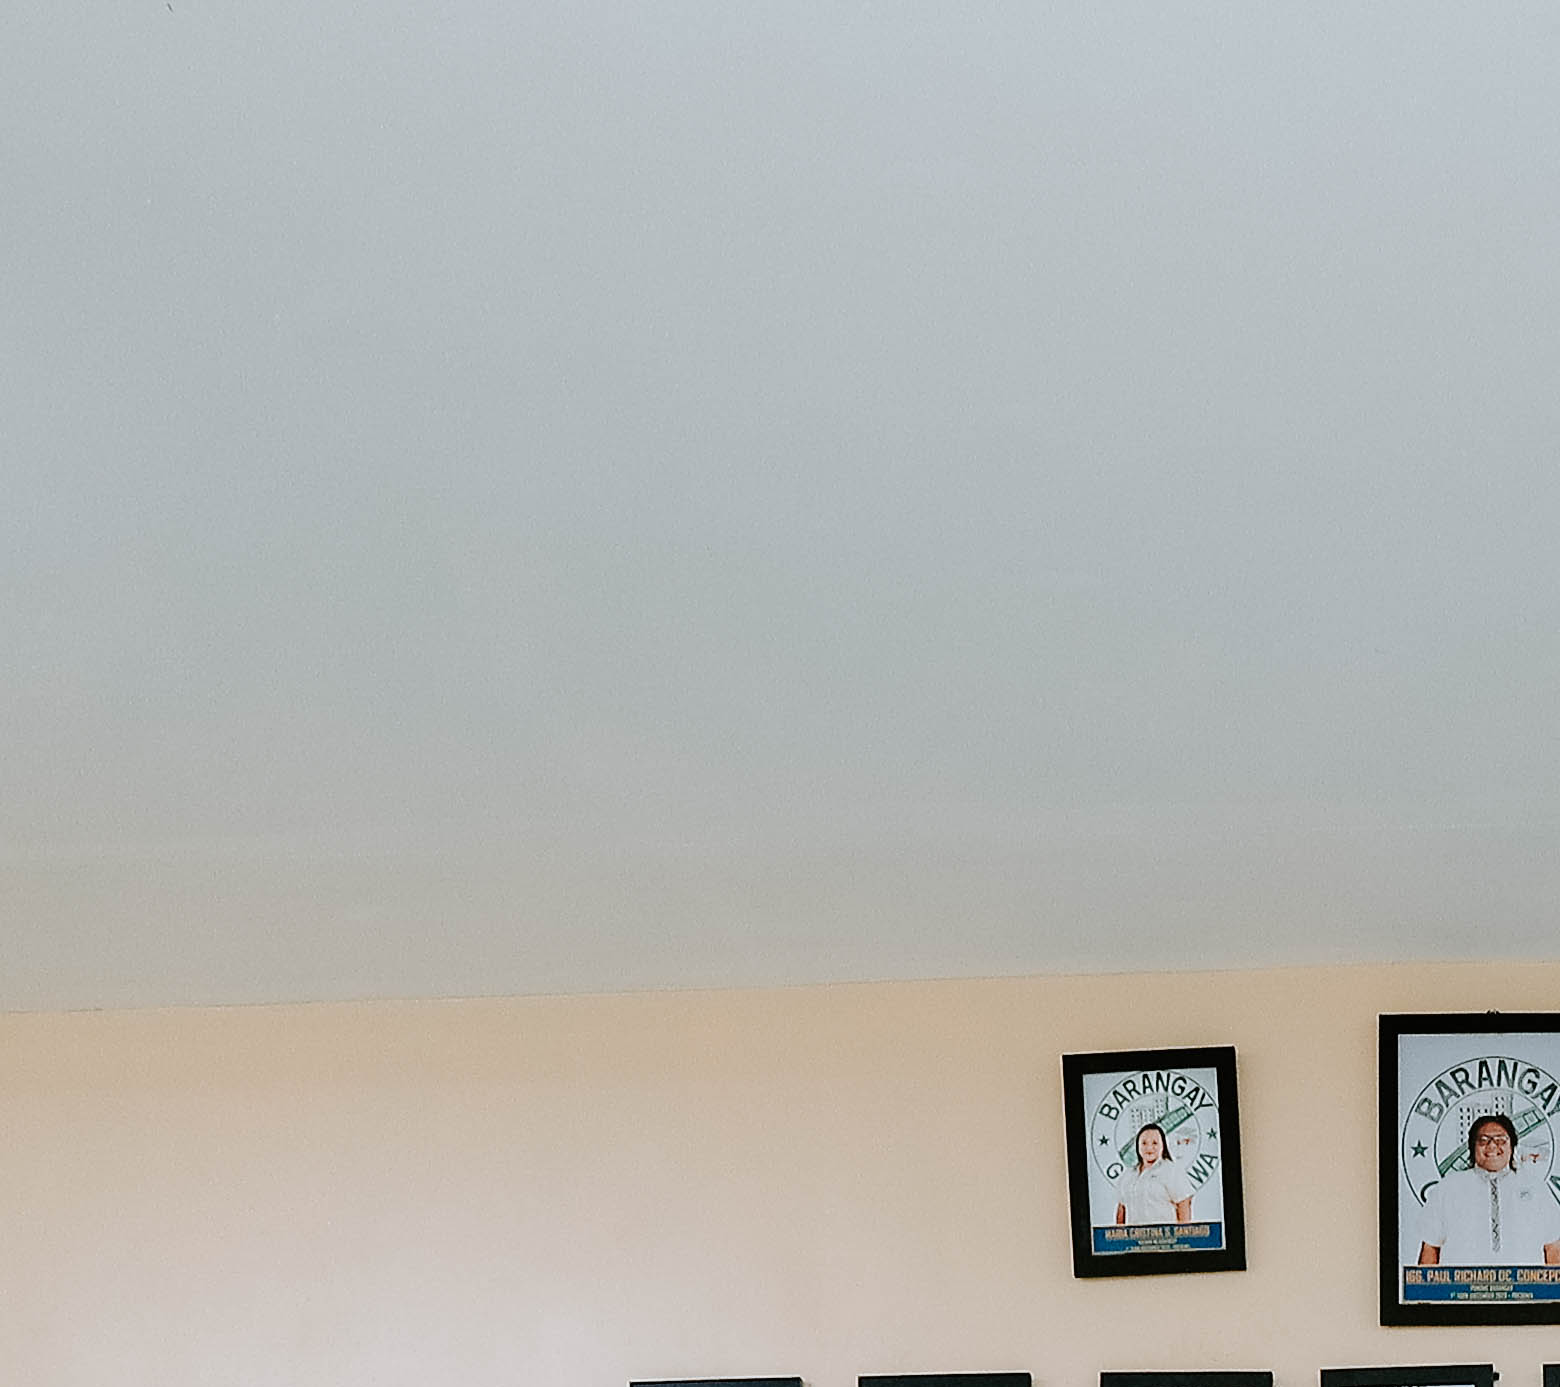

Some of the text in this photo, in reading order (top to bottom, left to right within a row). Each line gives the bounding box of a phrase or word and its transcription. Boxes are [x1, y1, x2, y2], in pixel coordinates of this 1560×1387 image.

[1099, 1072, 1213, 1120] BARANGAY
[1427, 1269, 1450, 1282] PAUL
[1454, 1269, 1496, 1282] RICHARD
